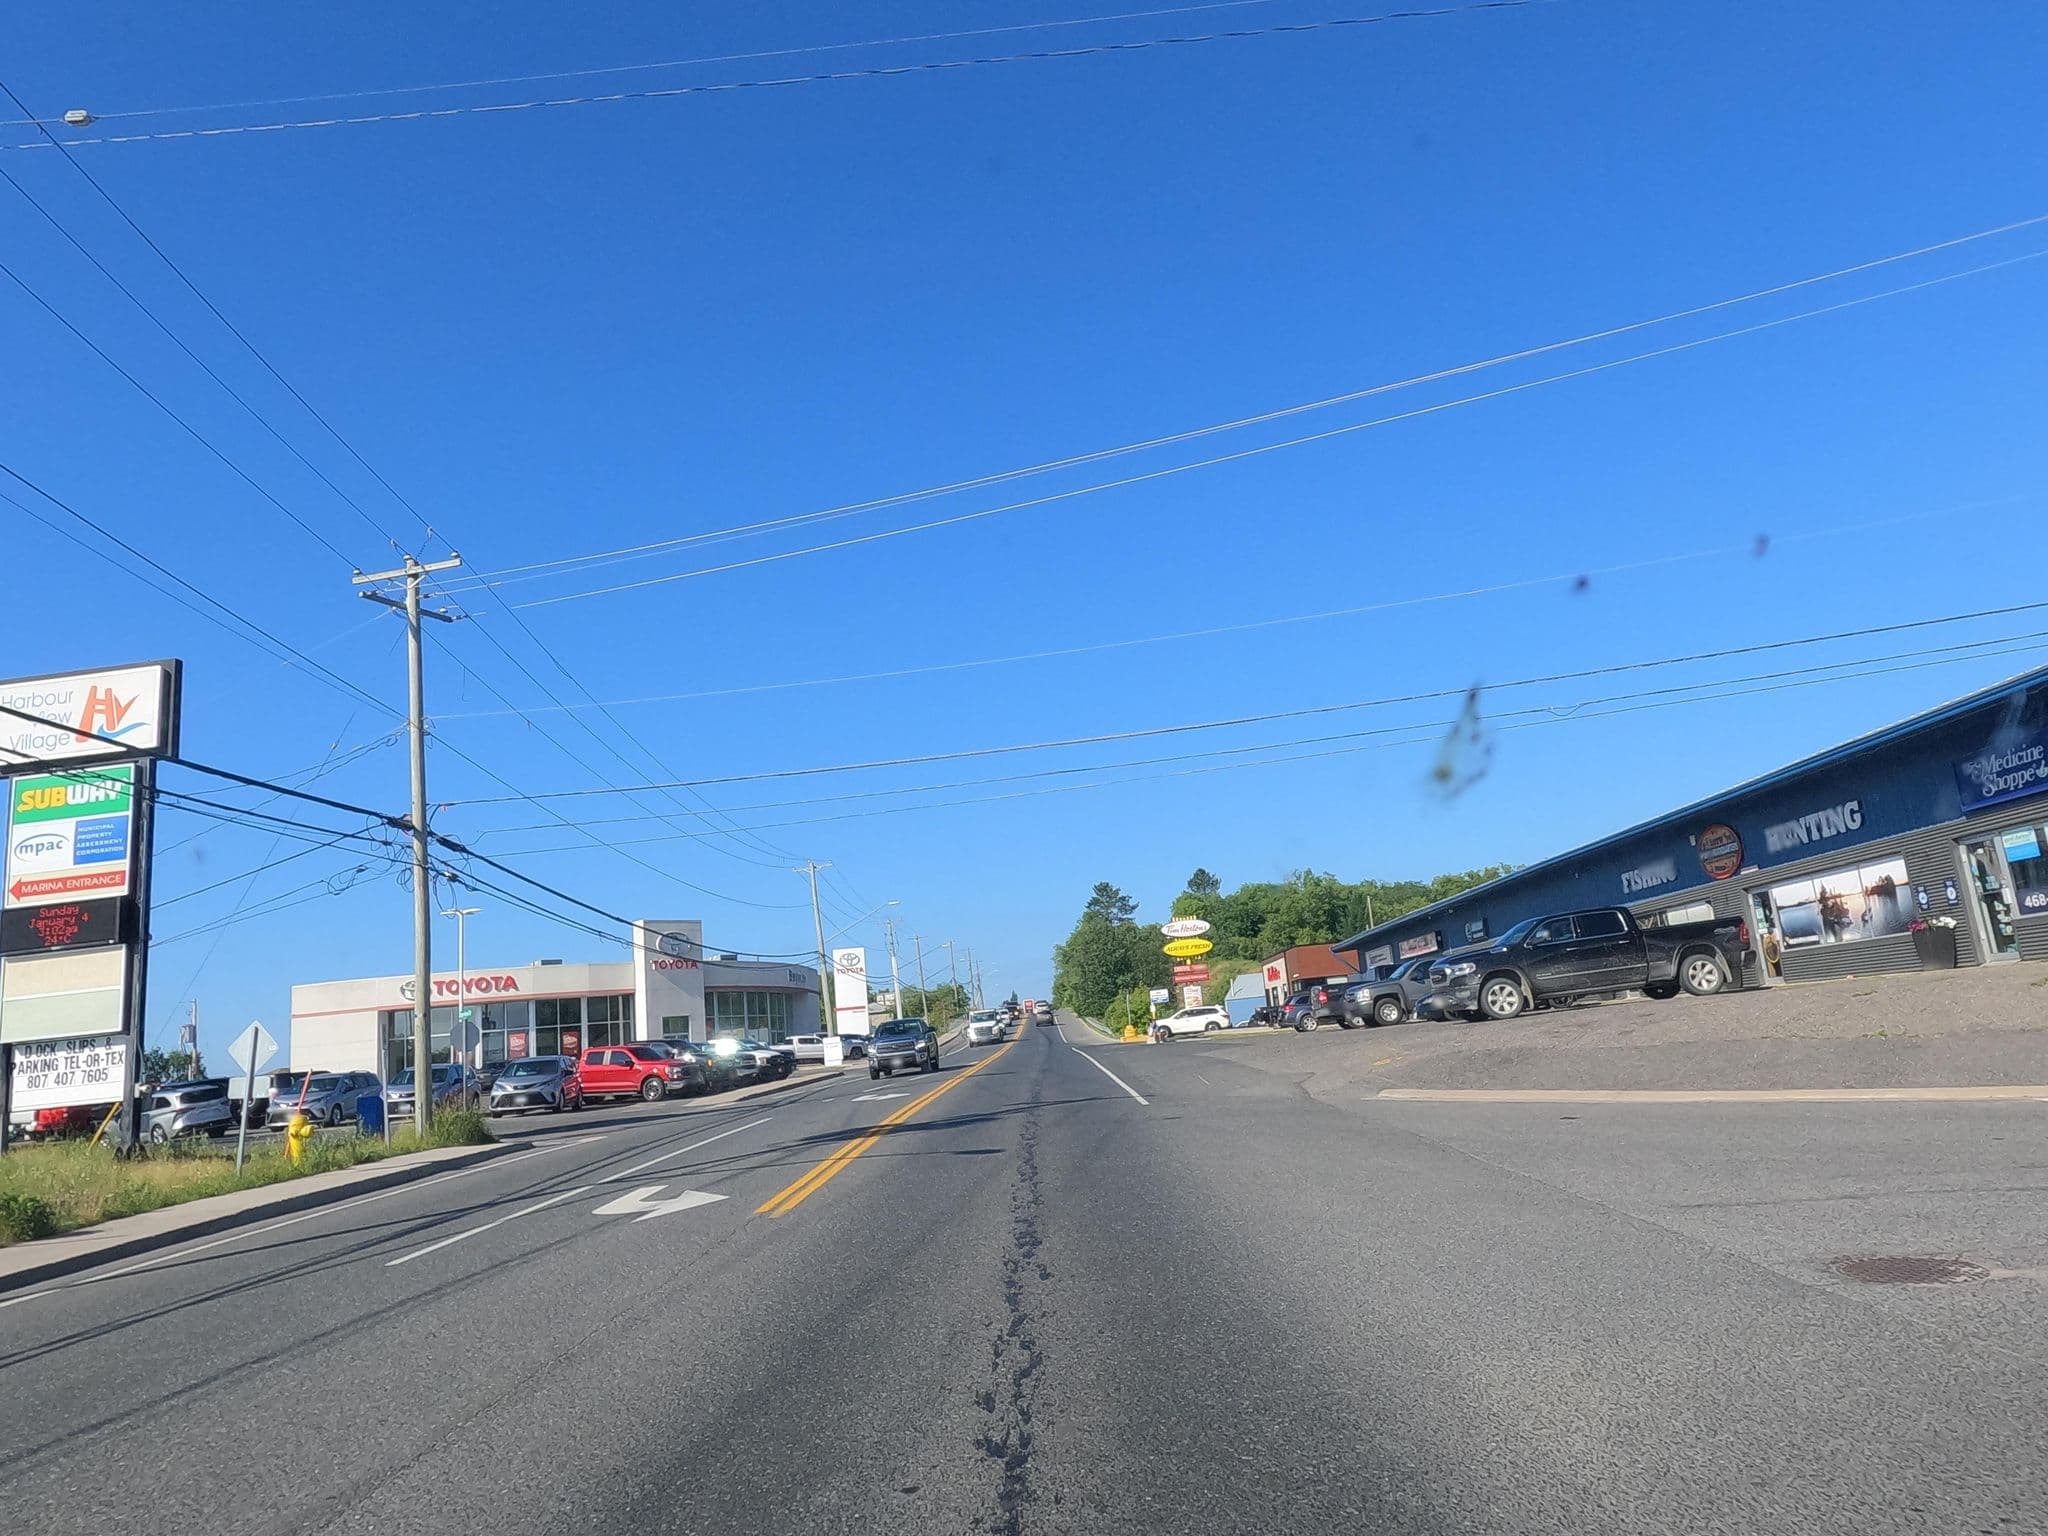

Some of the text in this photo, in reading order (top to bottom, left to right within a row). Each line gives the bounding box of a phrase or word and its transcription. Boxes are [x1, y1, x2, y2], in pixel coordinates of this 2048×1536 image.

[1, 690, 73, 711] Harbour
[9, 732, 70, 751] Village
[1982, 744, 2044, 773] Medicine
[1983, 767, 2035, 797] Shoppe
[16, 780, 123, 812] SUBWAY
[1764, 800, 1862, 854] NTING
[19, 839, 63, 857] mpac
[21, 875, 122, 894] MARINA ENTRANCE
[28, 912, 89, 929] January 4
[40, 905, 80, 918] Sunday
[1166, 924, 1180, 934] Tim
[650, 959, 698, 970] TOYOTA
[433, 976, 519, 996] TOYOTA
[66, 1039, 97, 1055] SLIPS
[105, 1037, 113, 1050] &
[10, 1051, 124, 1075] PARKING TEL-OR-TEX
[27, 1067, 109, 1089] 807 407 7605
